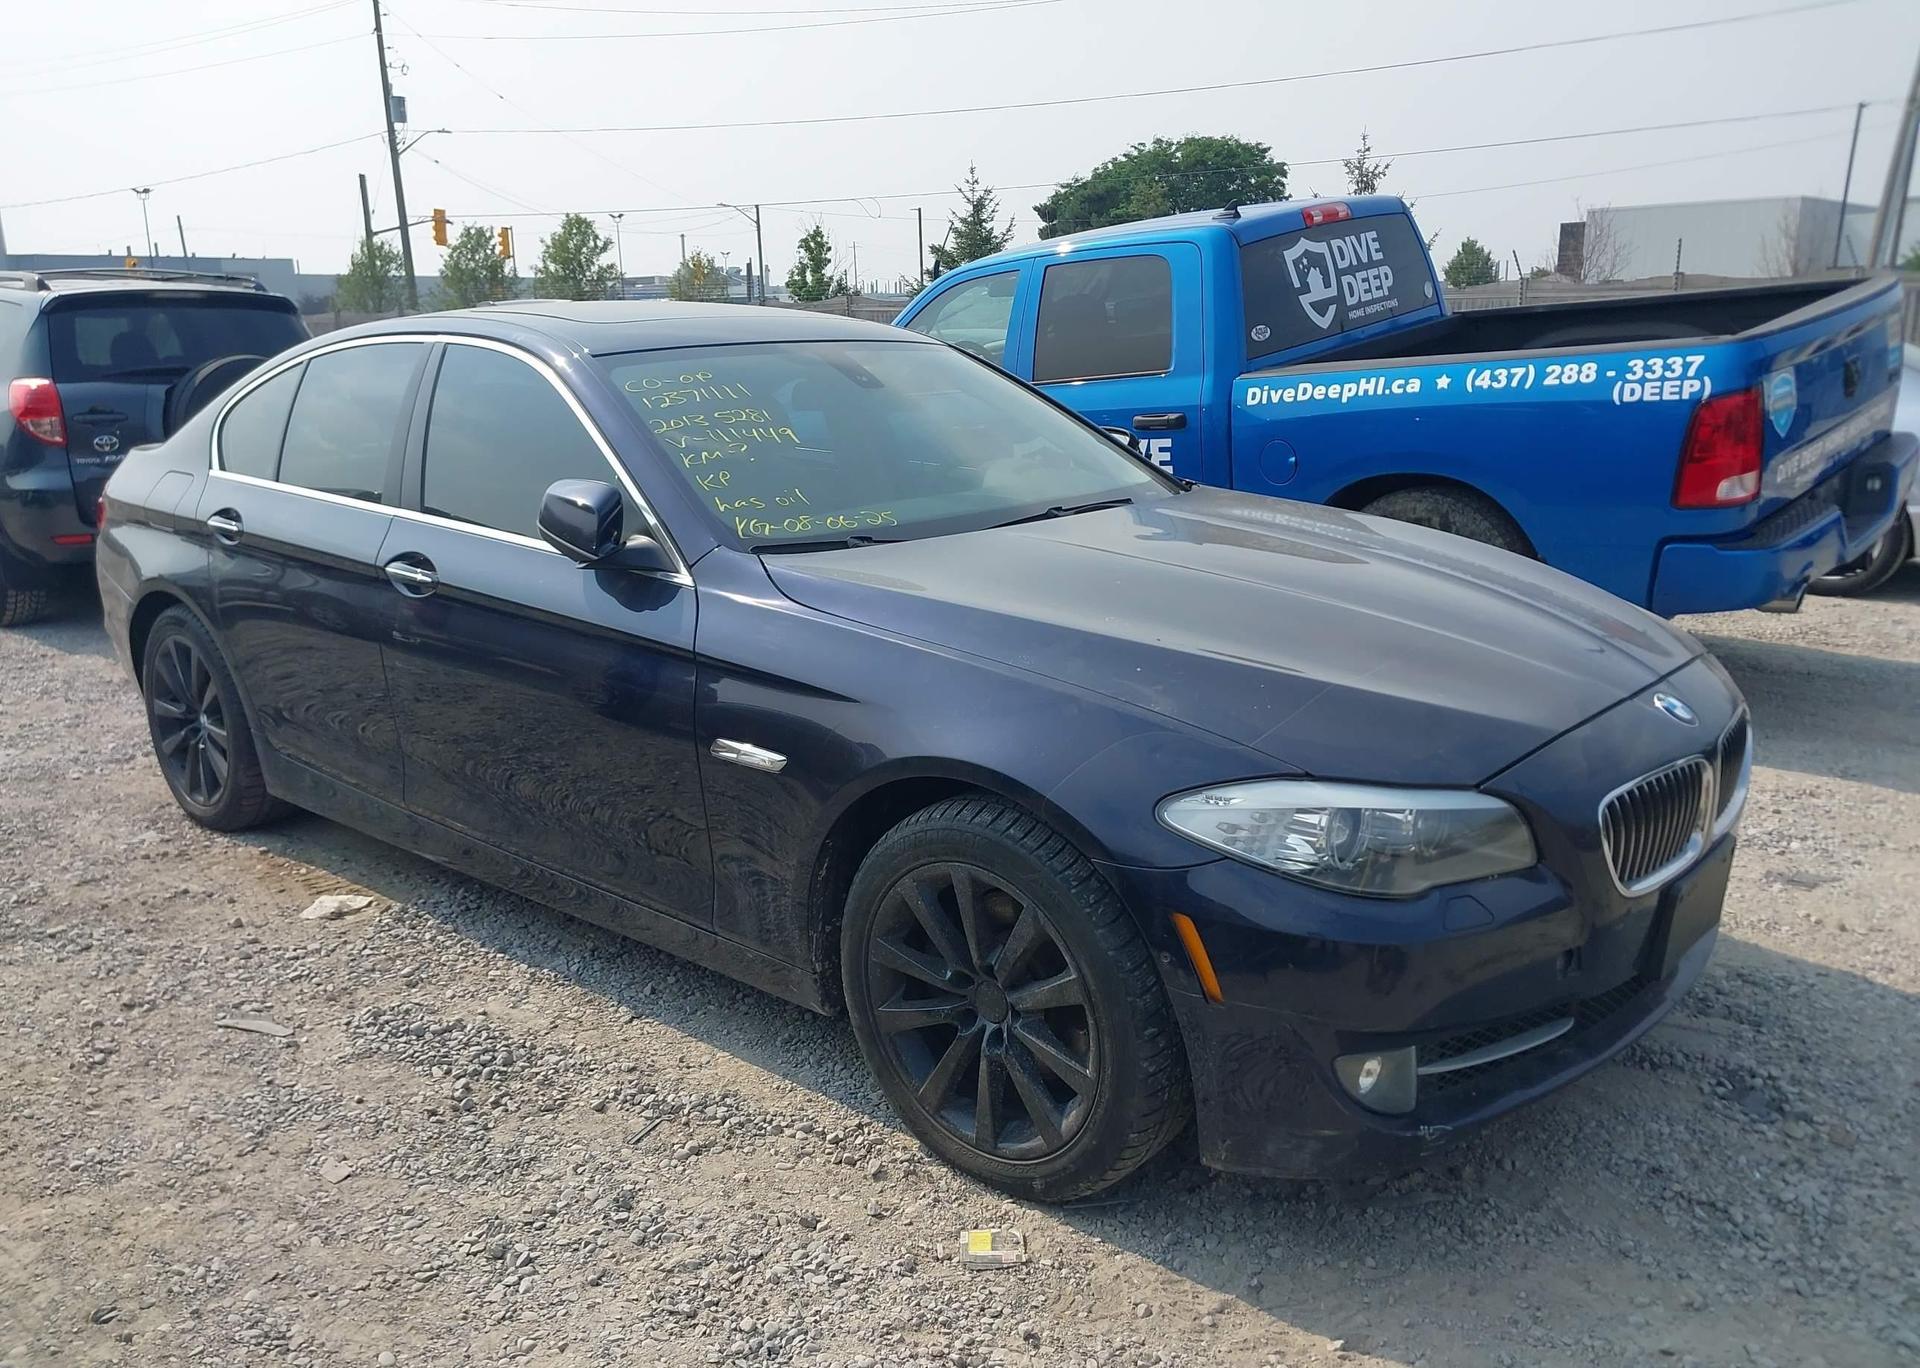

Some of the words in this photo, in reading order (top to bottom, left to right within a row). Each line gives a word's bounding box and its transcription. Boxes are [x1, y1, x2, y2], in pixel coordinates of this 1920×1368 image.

[1330, 230, 1384, 269] DIVE
[1340, 265, 1394, 306] DEEP
[1348, 307, 1365, 320] HOME
[1365, 298, 1399, 315] INSPECTIONS
[1246, 376, 1421, 406] DiveDeepHI.ca
[1466, 364, 1536, 393] (437)
[1543, 363, 1598, 386] 288
[1625, 355, 1705, 381] 3337
[1612, 376, 1712, 406] (DEEP)
[650, 414, 709, 434] 2013
[715, 497, 766, 512] has
[775, 488, 810, 505] oil
